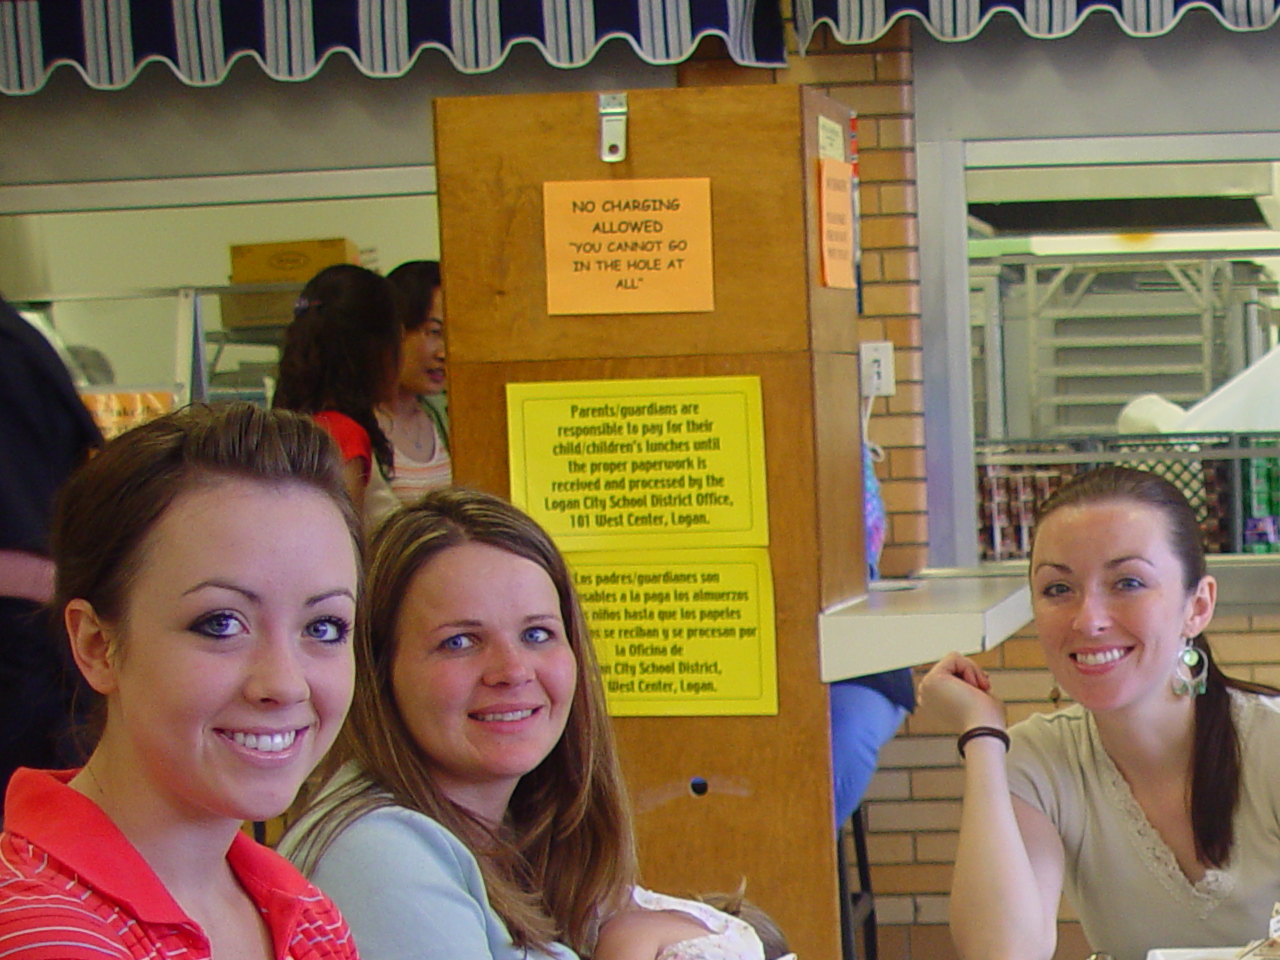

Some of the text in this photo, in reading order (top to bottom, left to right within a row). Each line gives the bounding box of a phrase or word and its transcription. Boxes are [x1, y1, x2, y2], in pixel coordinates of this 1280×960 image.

[572, 199, 680, 212] NO CHARGING
[592, 220, 663, 234] ALLOWED
[607, 241, 663, 252] CANNOT
[668, 240, 687, 251] GO
[573, 258, 684, 272] IN THE HOLE AT
[570, 402, 699, 420] Parents/guardians are
[558, 419, 713, 439] responsible to pay for their
[552, 438, 720, 457] child/children's lunches until
[568, 457, 707, 475] the proper paperwork is
[552, 474, 725, 493] received and processed by the
[544, 492, 733, 511] Logan City School District Office,
[570, 512, 710, 528] 101 West Center, Logan.
[701, 572, 719, 583] son
[620, 592, 627, 601] a
[629, 590, 641, 601] la
[674, 590, 690, 601] los
[692, 590, 749, 601] almuerzos
[624, 608, 654, 621] hasta
[657, 609, 676, 621] que
[680, 608, 696, 620] los
[699, 607, 742, 620] papeles
[604, 629, 615, 639] se
[618, 627, 659, 639] reciban
[662, 628, 669, 640] y
[672, 627, 684, 637] se
[686, 627, 736, 640] procesan
[739, 627, 756, 639] por
[615, 644, 684, 656] la Oficina de
[614, 663, 636, 676] City
[639, 662, 675, 675] School
[678, 661, 722, 675] District,
[607, 681, 717, 694] West Center, Logan.
